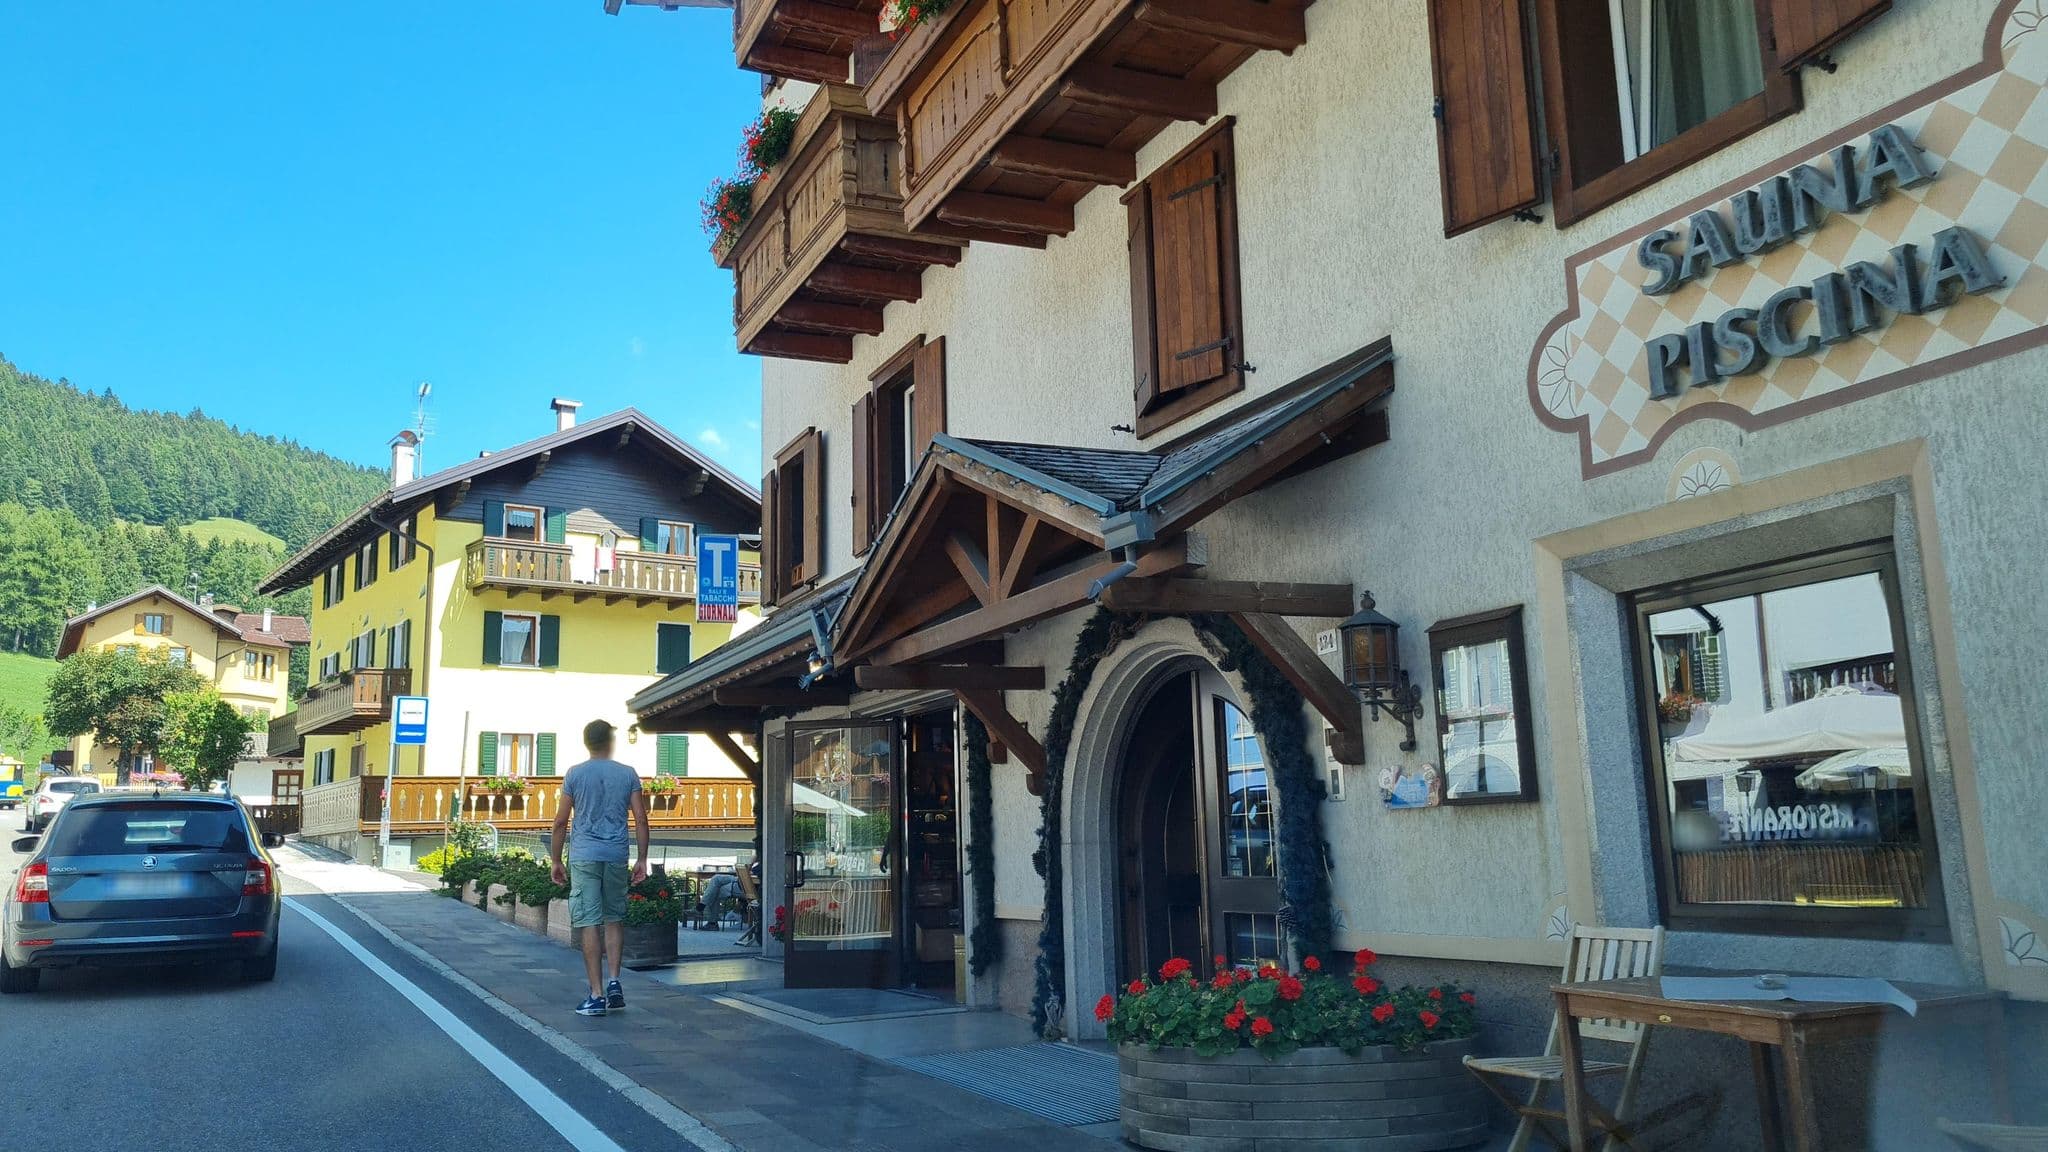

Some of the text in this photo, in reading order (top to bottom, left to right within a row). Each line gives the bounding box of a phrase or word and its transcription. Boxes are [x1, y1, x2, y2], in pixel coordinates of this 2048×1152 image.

[1637, 124, 1937, 295] SAUNA
[1644, 225, 2006, 400] PISCINA
[704, 542, 731, 588] T
[699, 604, 736, 621] GIORNALI
[701, 594, 736, 603] TABACCHI
